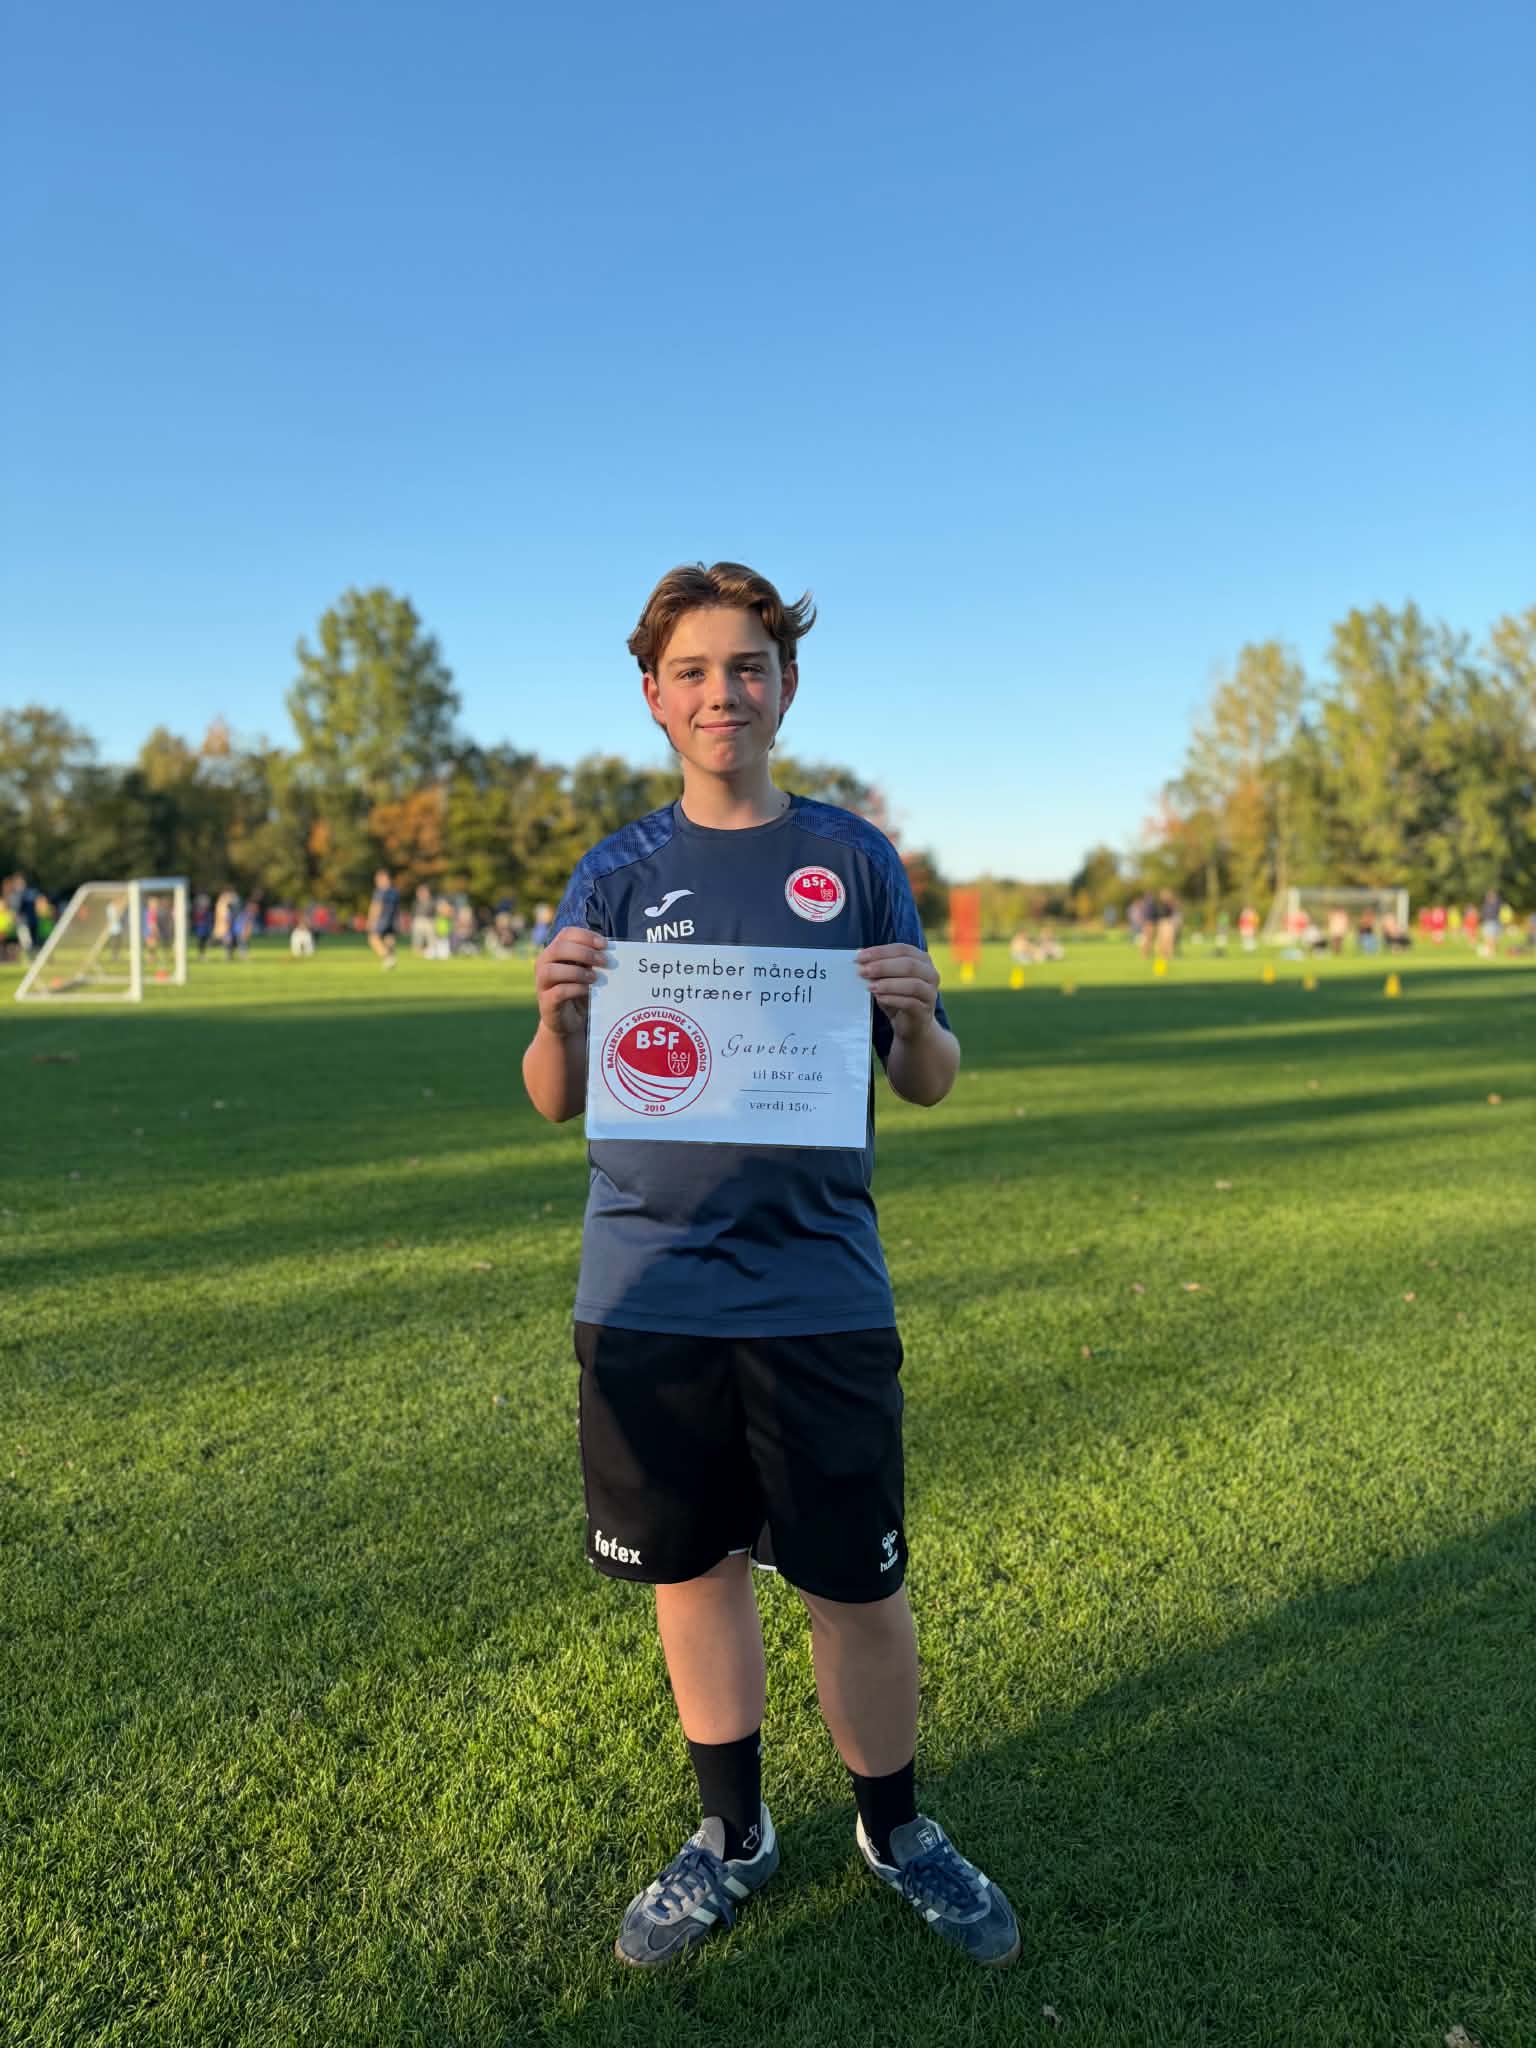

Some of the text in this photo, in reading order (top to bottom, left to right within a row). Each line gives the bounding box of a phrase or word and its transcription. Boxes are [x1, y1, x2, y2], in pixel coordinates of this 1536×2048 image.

[802, 876, 827, 889] BSF
[646, 919, 695, 943] MNB
[638, 957, 827, 980] September måneds
[651, 984, 813, 1007] ungtræner profil
[607, 1010, 707, 1072] BALLERUP SKOVLUNDE FODBOLD
[636, 1026, 680, 1050] BSF
[721, 1032, 817, 1058] Gavekort
[753, 1070, 766, 1080] til
[798, 1071, 823, 1082] café
[643, 1104, 666, 1112] 2010
[749, 1101, 784, 1112] værdi
